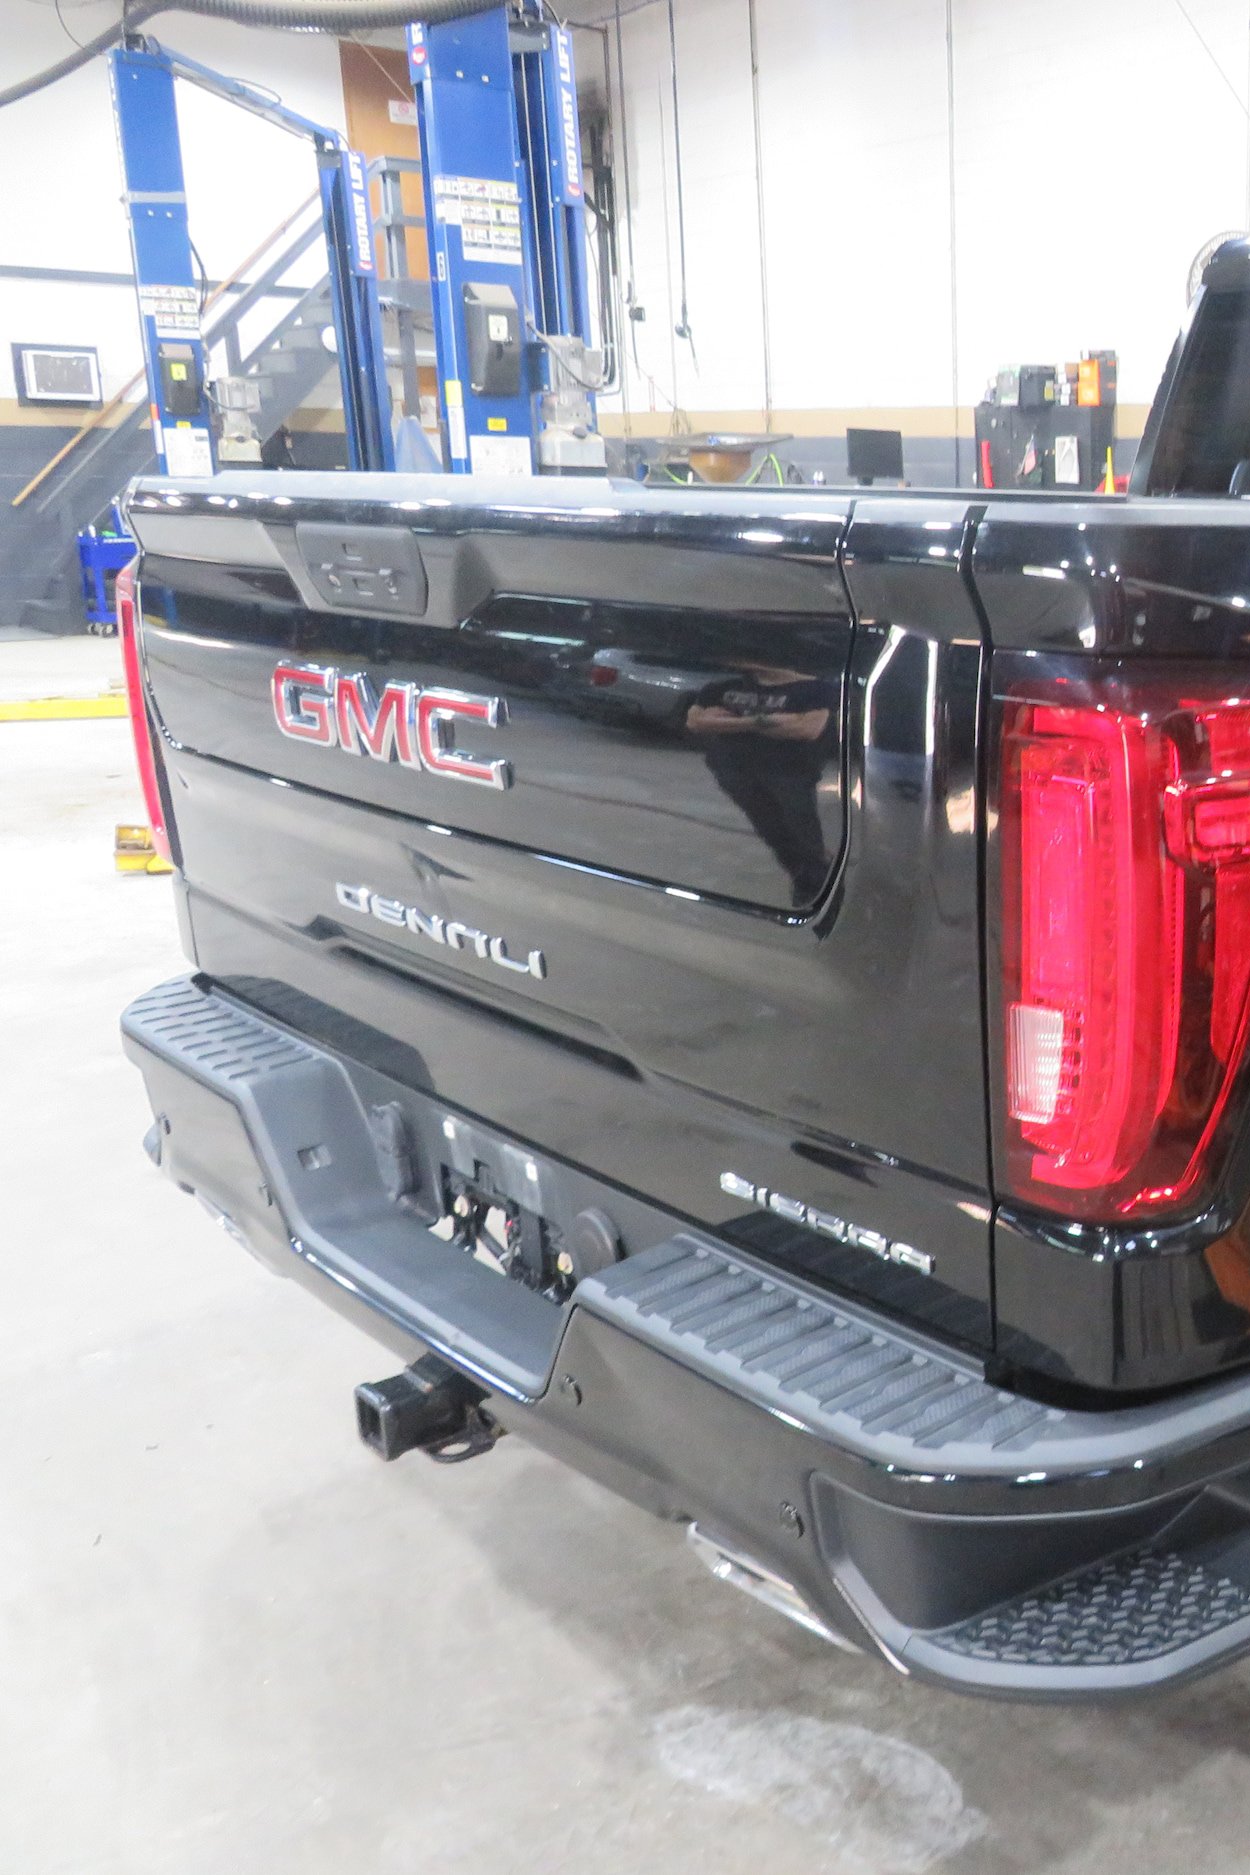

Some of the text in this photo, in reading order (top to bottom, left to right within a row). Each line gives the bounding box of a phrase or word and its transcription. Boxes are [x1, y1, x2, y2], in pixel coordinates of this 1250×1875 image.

[556, 30, 578, 184] ROTARY LIFT
[347, 151, 371, 261] ROTARY LIFT
[271, 659, 509, 791] GMC
[335, 881, 548, 980] DENALI
[720, 1172, 936, 1276] SIERRA
